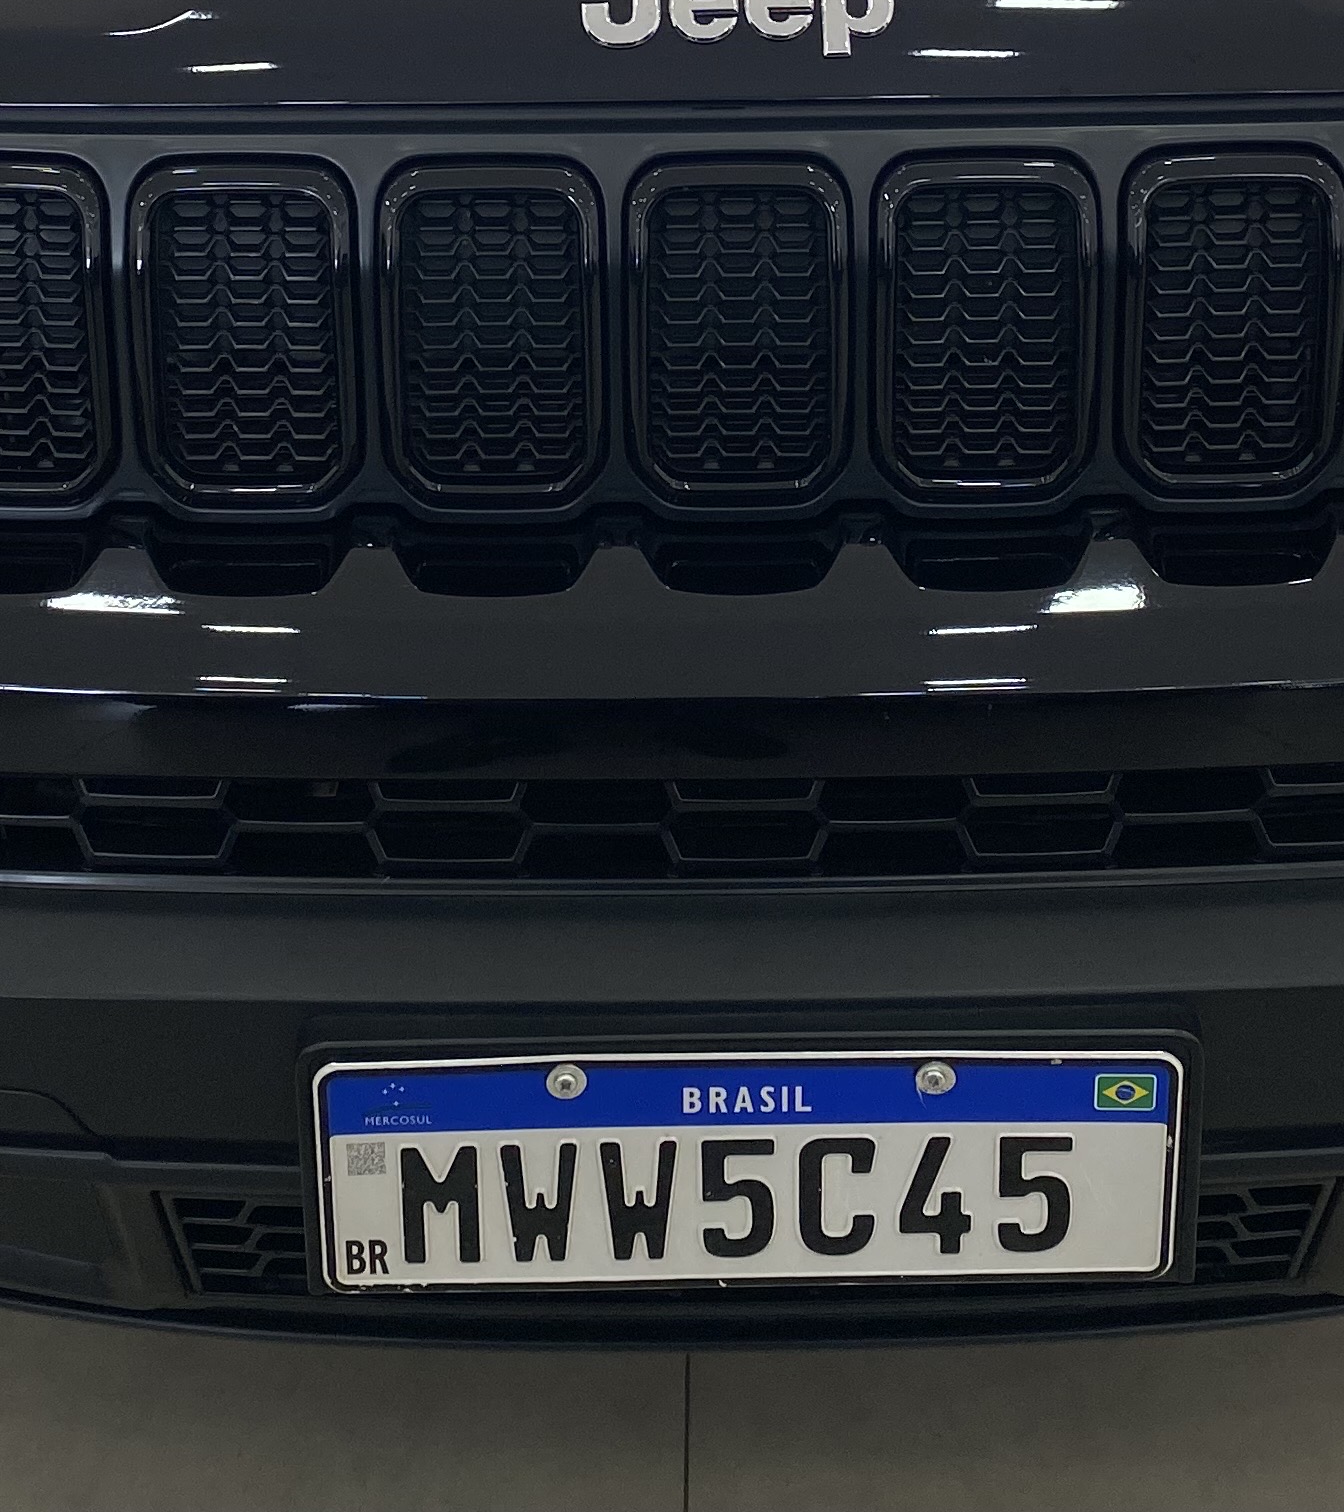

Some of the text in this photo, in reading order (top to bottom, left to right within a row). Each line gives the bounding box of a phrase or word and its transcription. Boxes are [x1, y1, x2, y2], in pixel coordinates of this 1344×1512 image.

[682, 1085, 813, 1114] BRASIL
[363, 1115, 433, 1126] MERCOSUL
[400, 1137, 1074, 1263] MWW5C45
[346, 1239, 390, 1275] BR
